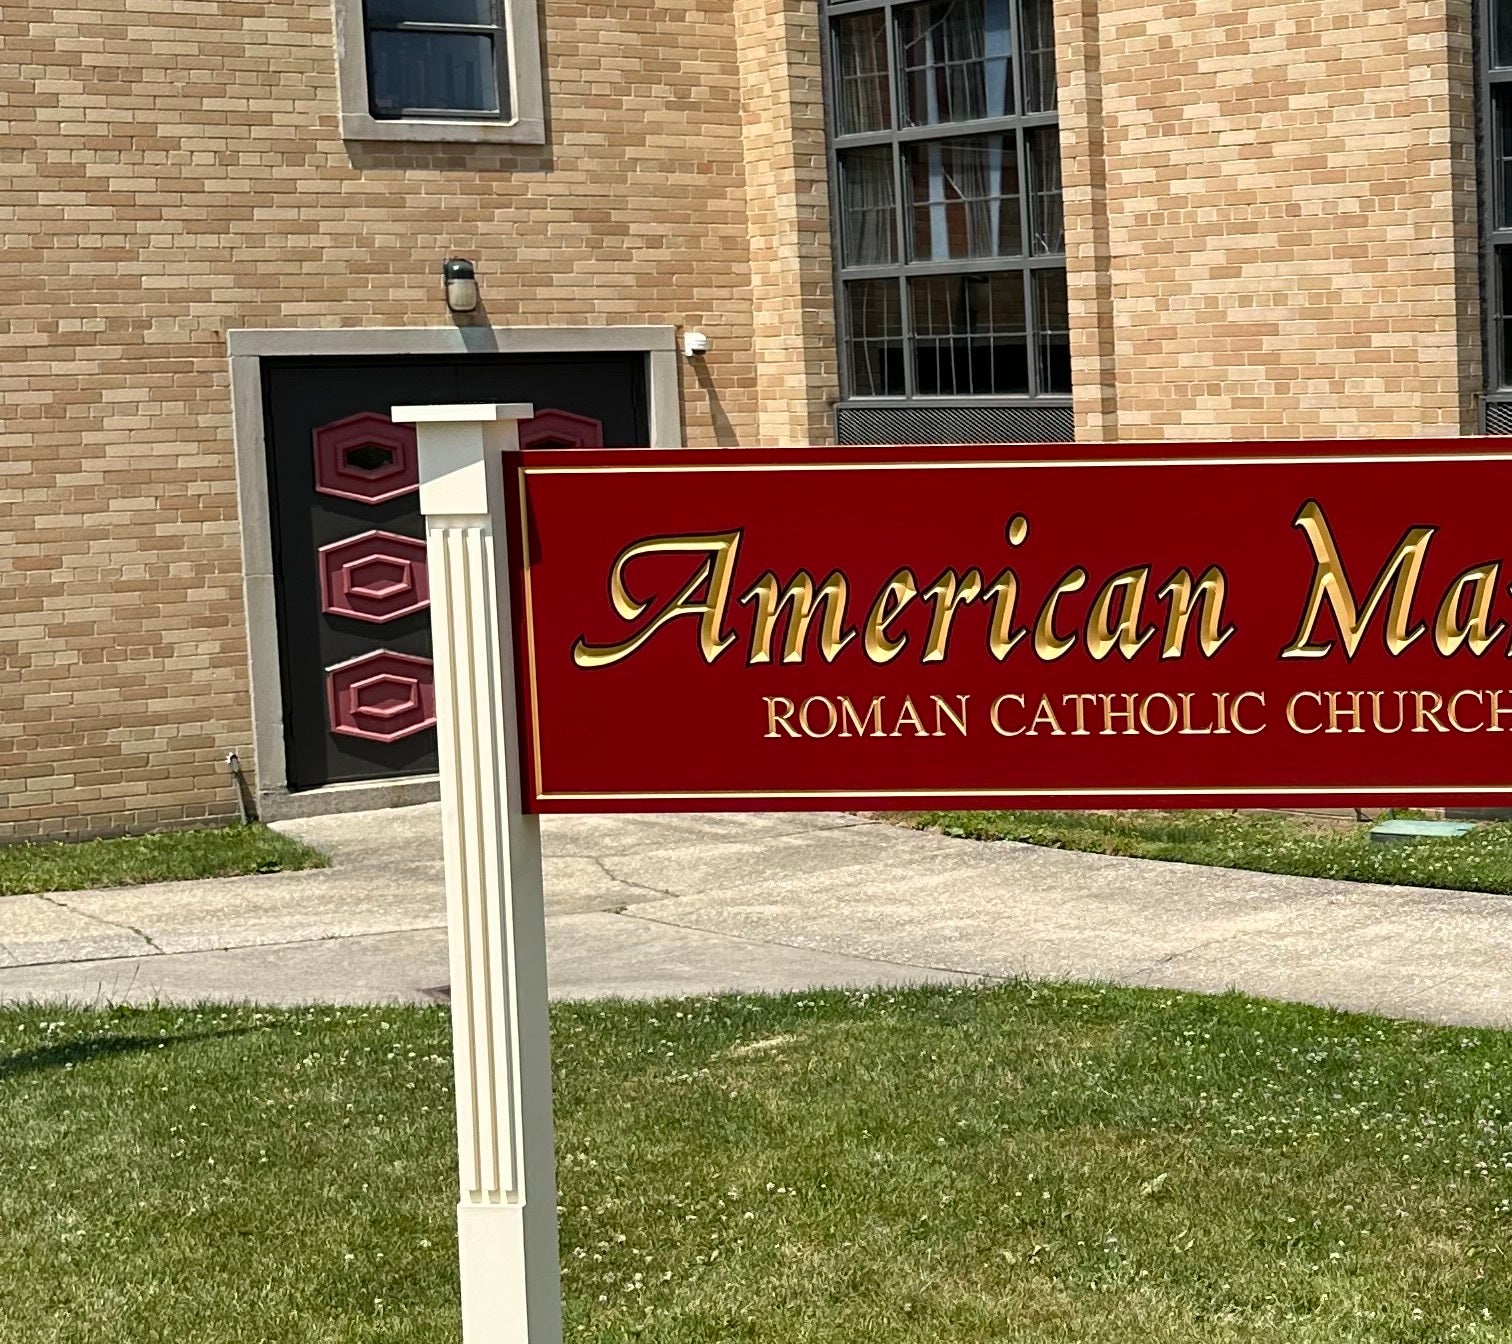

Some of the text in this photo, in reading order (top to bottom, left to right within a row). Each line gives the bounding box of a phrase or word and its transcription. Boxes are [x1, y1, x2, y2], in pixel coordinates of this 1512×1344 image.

[572, 513, 1236, 669] American
[763, 694, 970, 739] ROMAN
[989, 690, 1267, 737] CATHOLIC
